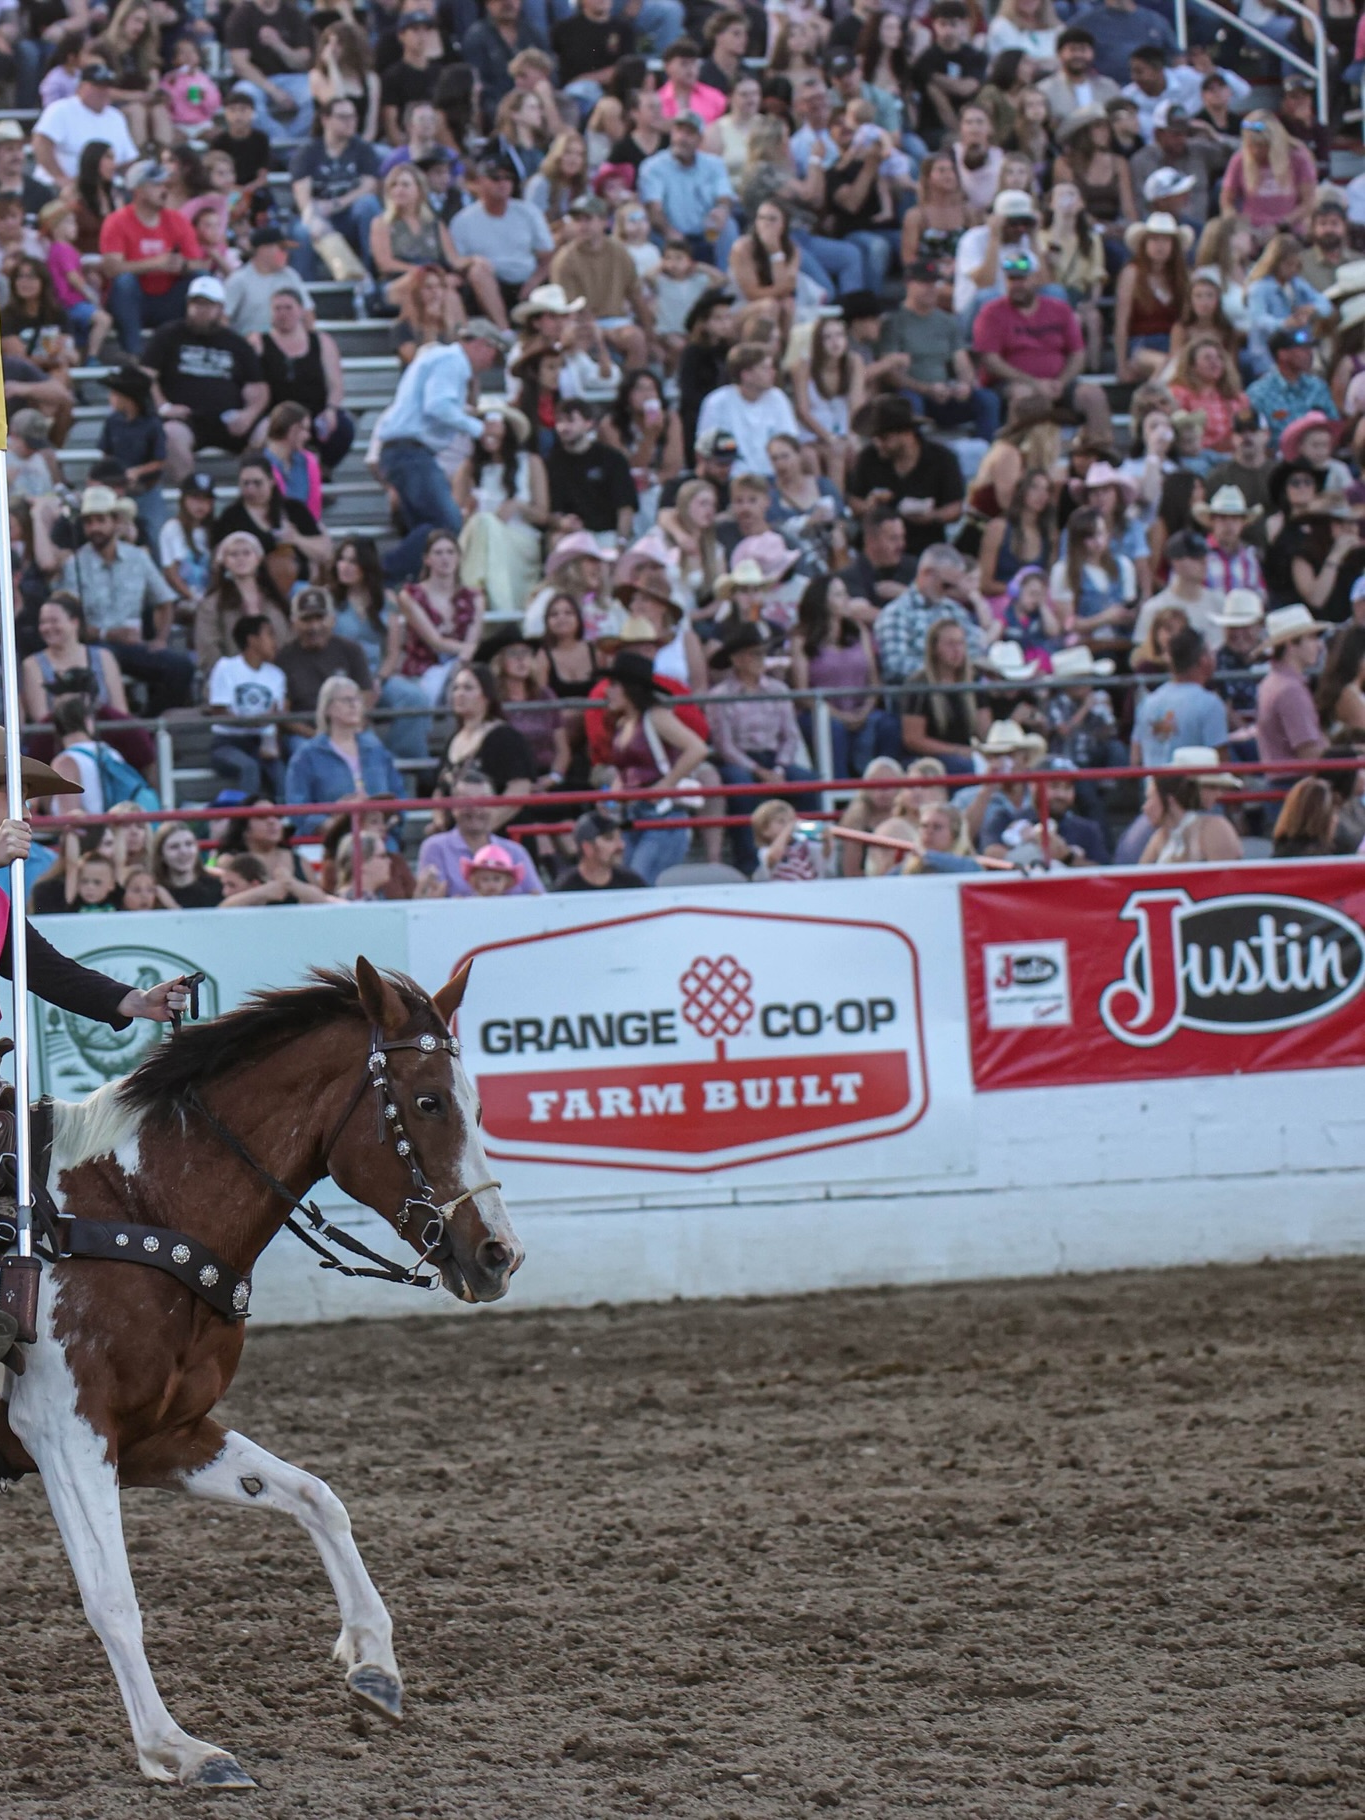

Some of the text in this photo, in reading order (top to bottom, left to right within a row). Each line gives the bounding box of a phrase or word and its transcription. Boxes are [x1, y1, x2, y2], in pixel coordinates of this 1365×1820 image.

[1100, 888, 1349, 1047] Justin
[479, 1009, 678, 1055] GRANGE
[527, 1072, 864, 1122] FARM BUILT
